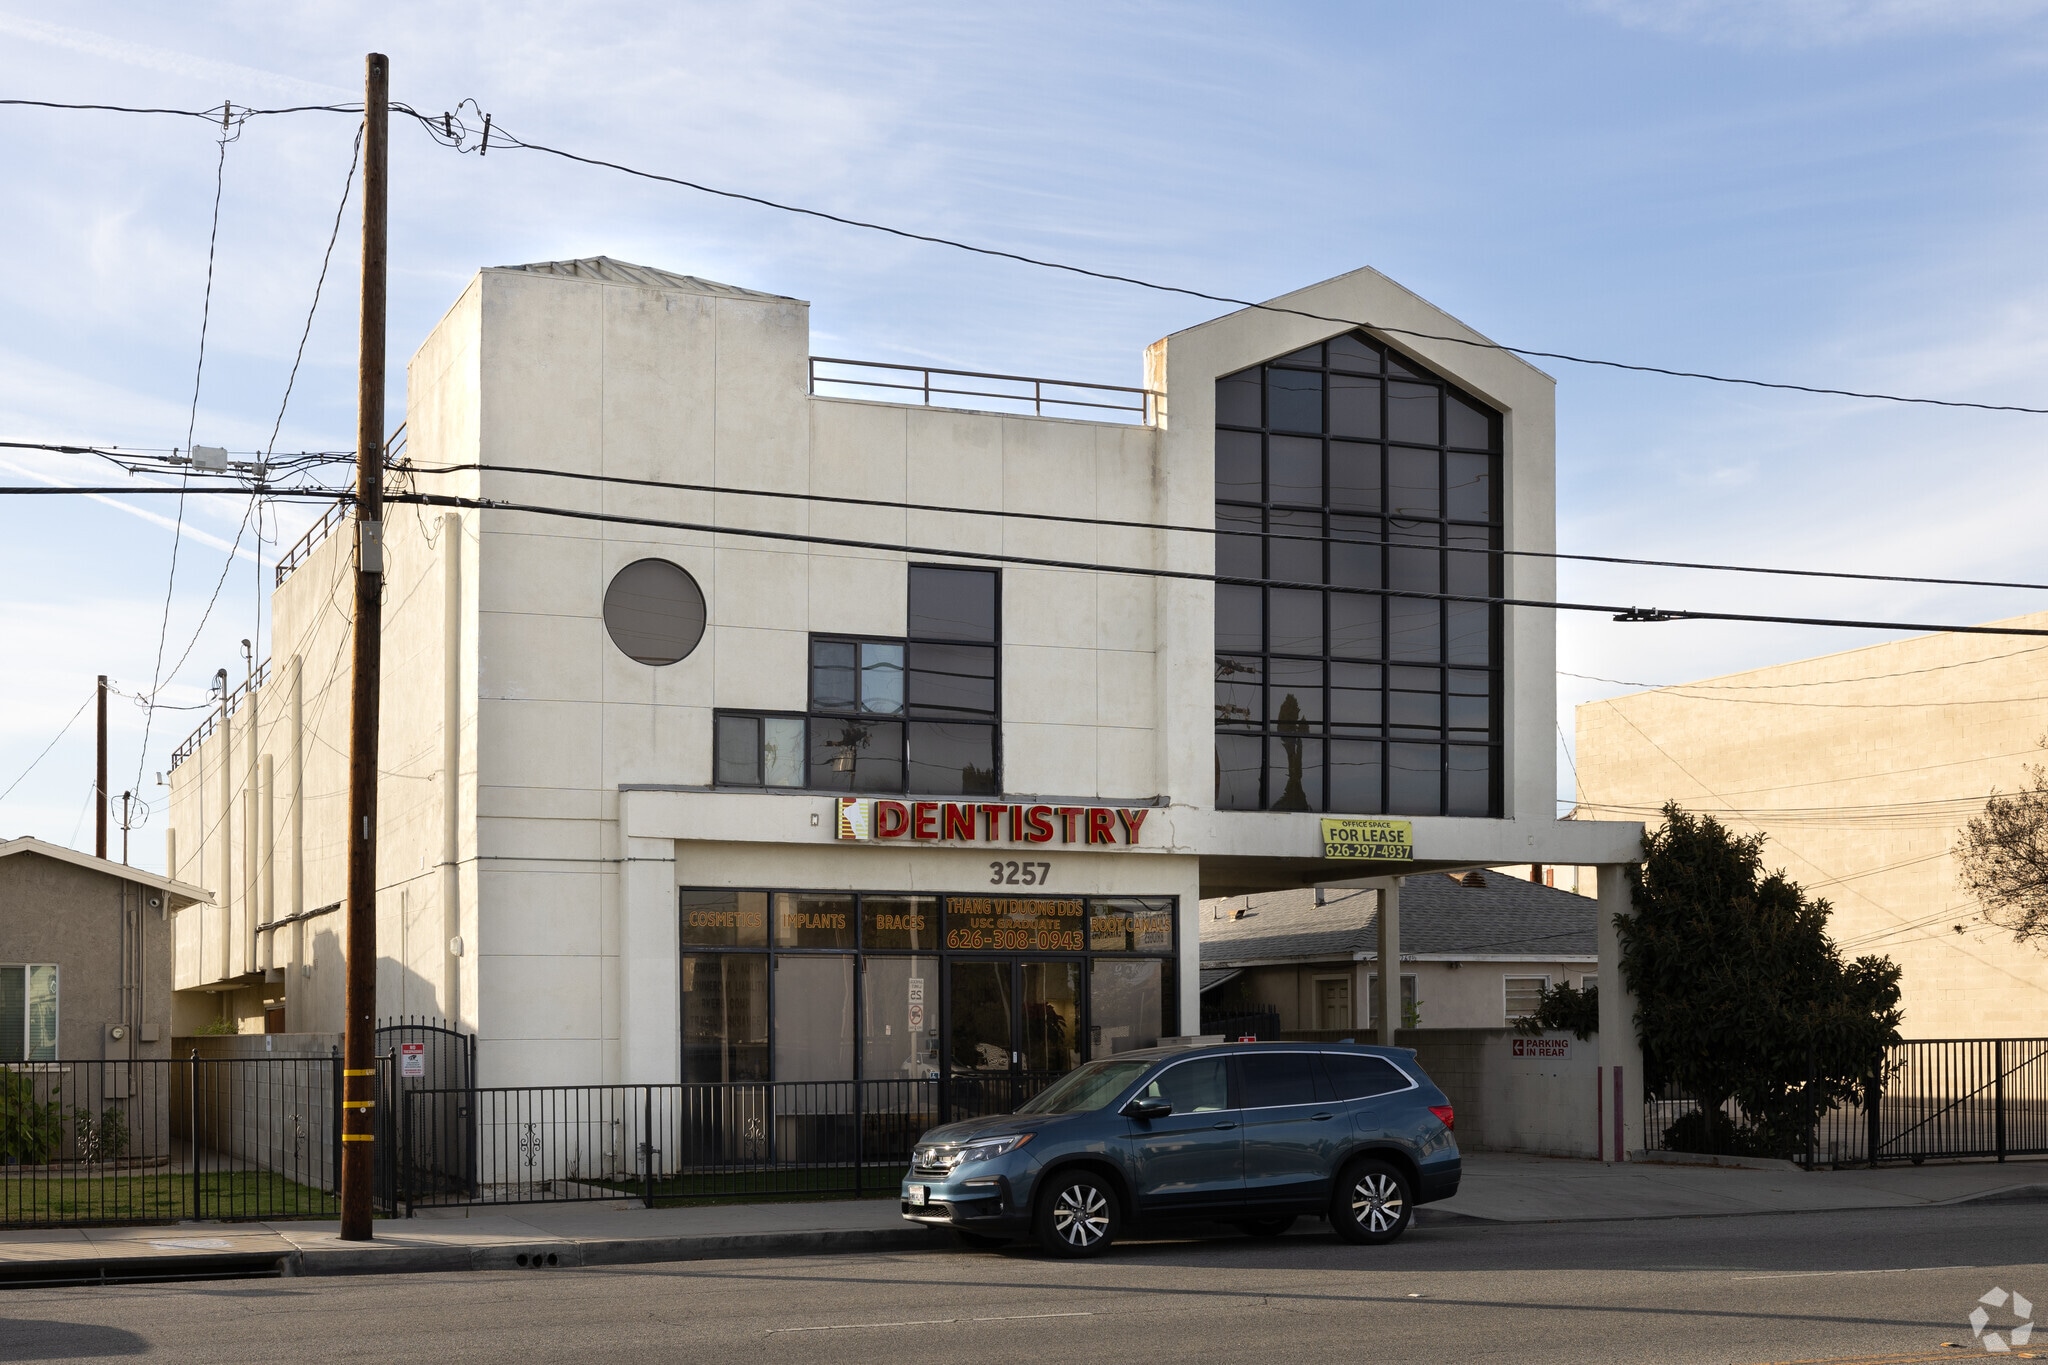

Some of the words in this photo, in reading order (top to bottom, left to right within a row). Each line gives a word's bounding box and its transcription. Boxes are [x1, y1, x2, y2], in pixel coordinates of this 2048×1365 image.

[875, 800, 1149, 845] DENTISTRY
[1330, 828, 1359, 841] FOR
[1362, 829, 1404, 843] LEASE
[1325, 843, 1411, 859] 626-297-4937
[989, 861, 1051, 886] 3257
[946, 898, 991, 914] THANG
[993, 899, 1008, 914] VI
[1009, 899, 1056, 916] DUONG
[1057, 900, 1084, 917] DDS
[689, 911, 762, 927] COSMETICS
[783, 913, 846, 929] IMPLANTS
[876, 914, 925, 931] BRACES
[970, 918, 994, 929] USC
[996, 918, 1061, 930] GRADUATE
[1090, 917, 1123, 932] ROOT
[1125, 917, 1172, 933] CANALS
[947, 929, 1084, 950] 626-308-0943
[1526, 1039, 1569, 1048] PARKING
[1526, 1048, 1536, 1056] IN
[1539, 1048, 1565, 1057] REAR
